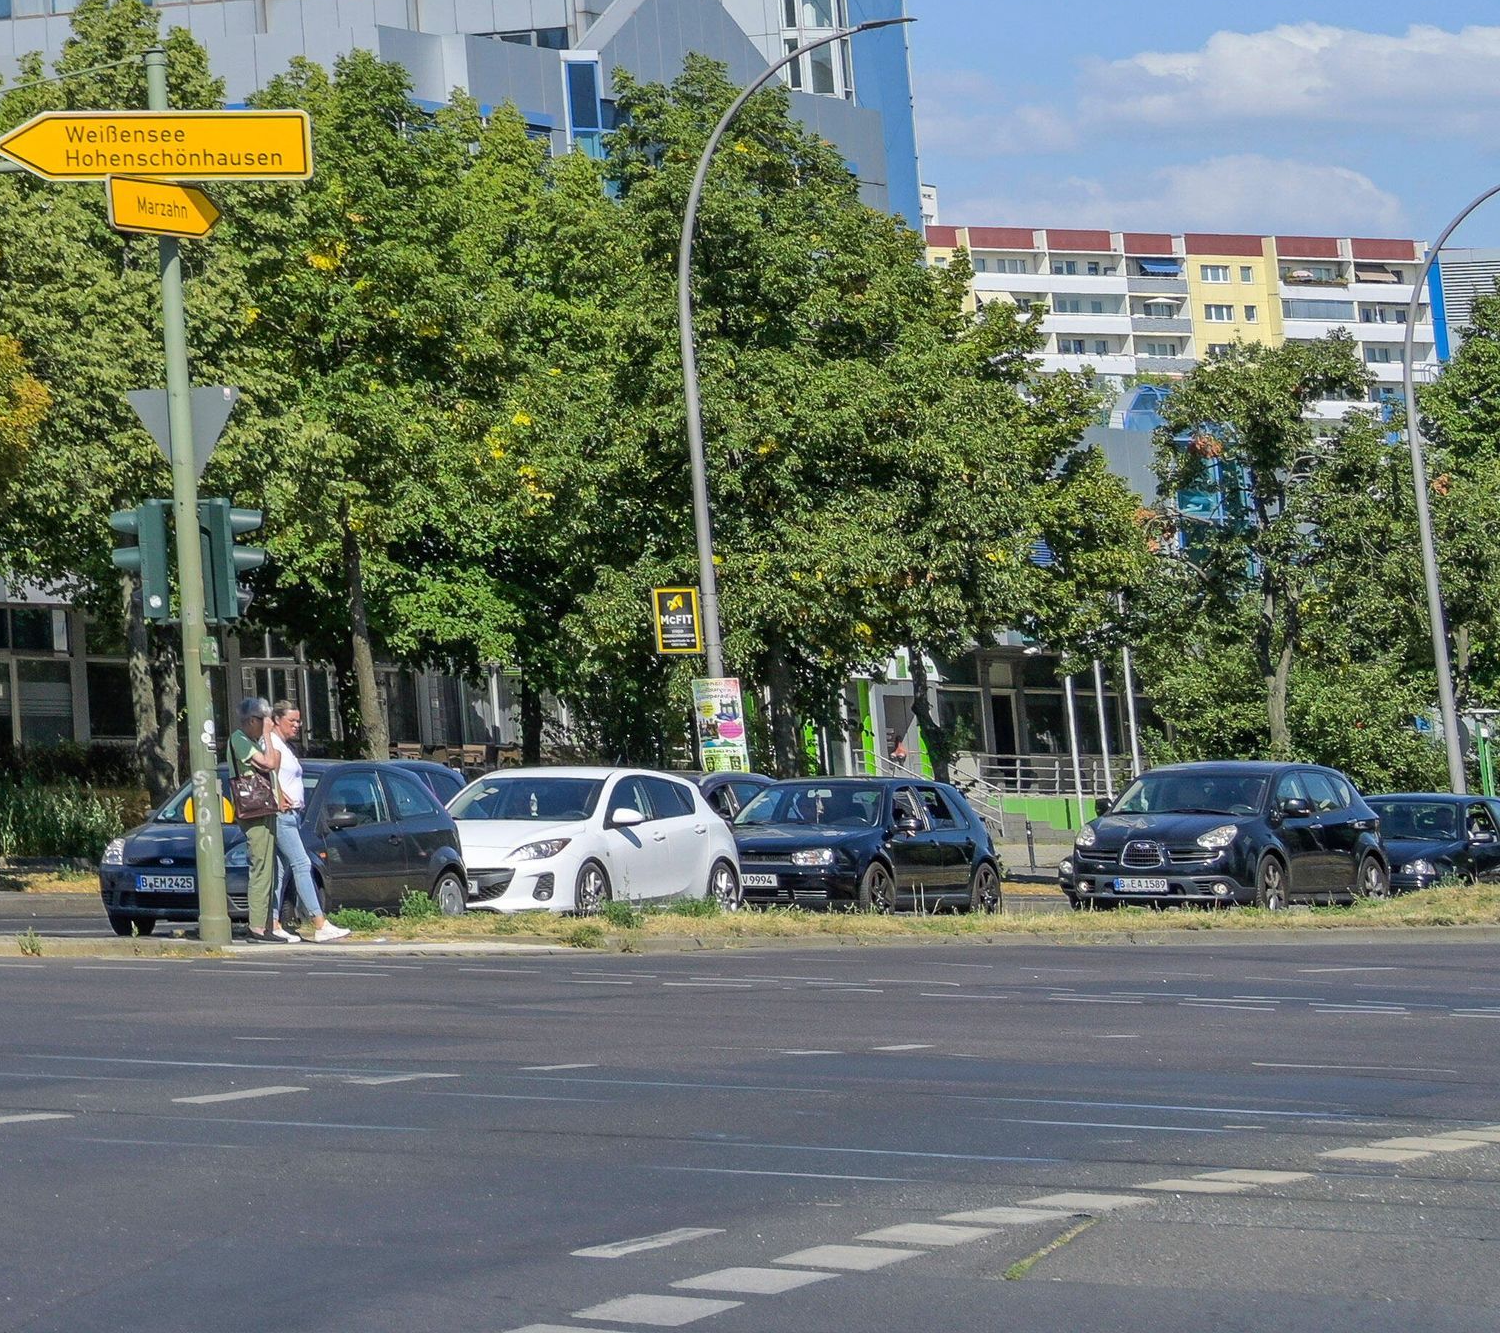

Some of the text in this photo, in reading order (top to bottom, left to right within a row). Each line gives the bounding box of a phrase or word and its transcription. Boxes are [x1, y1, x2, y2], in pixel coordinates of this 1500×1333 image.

[66, 125, 186, 143] Weißensee
[66, 148, 283, 167] Hohenschönhausen
[137, 196, 188, 219] Marzahn
[660, 614, 693, 625] McFIT
